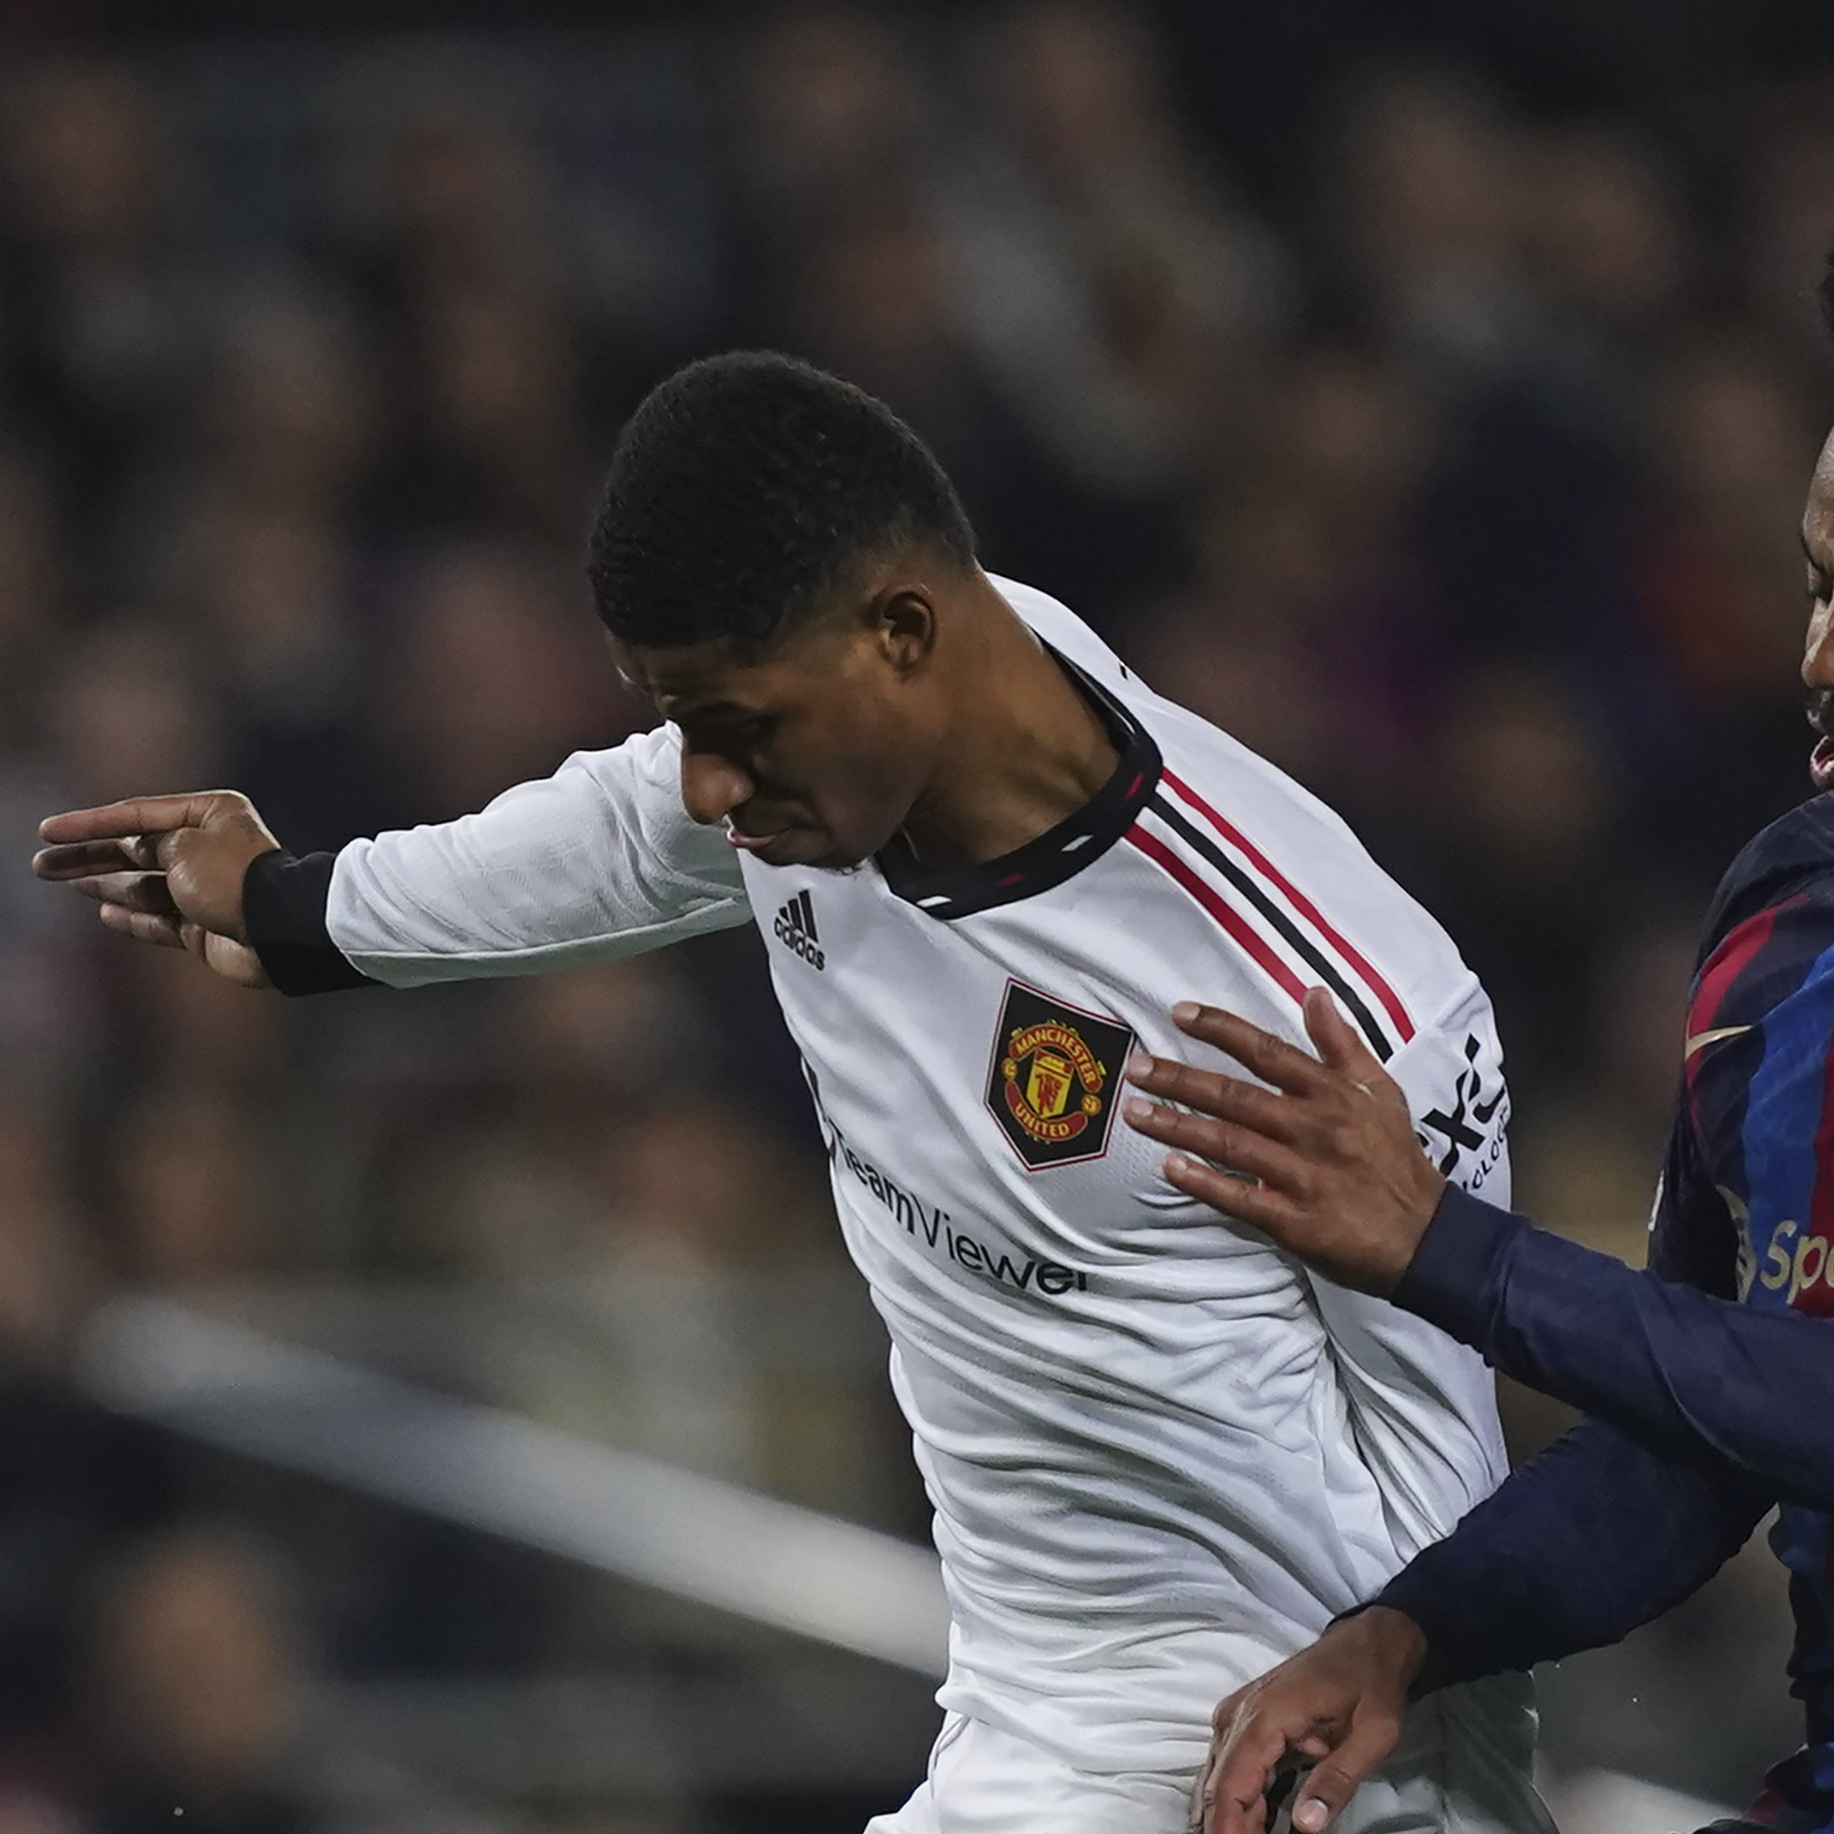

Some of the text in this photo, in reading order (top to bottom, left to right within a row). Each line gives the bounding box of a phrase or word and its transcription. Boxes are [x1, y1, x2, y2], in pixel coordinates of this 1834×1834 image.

[774, 916, 825, 972] adidas
[1016, 1025, 1097, 1085] MANCHESTER
[1015, 1103, 1070, 1137] UNITED
